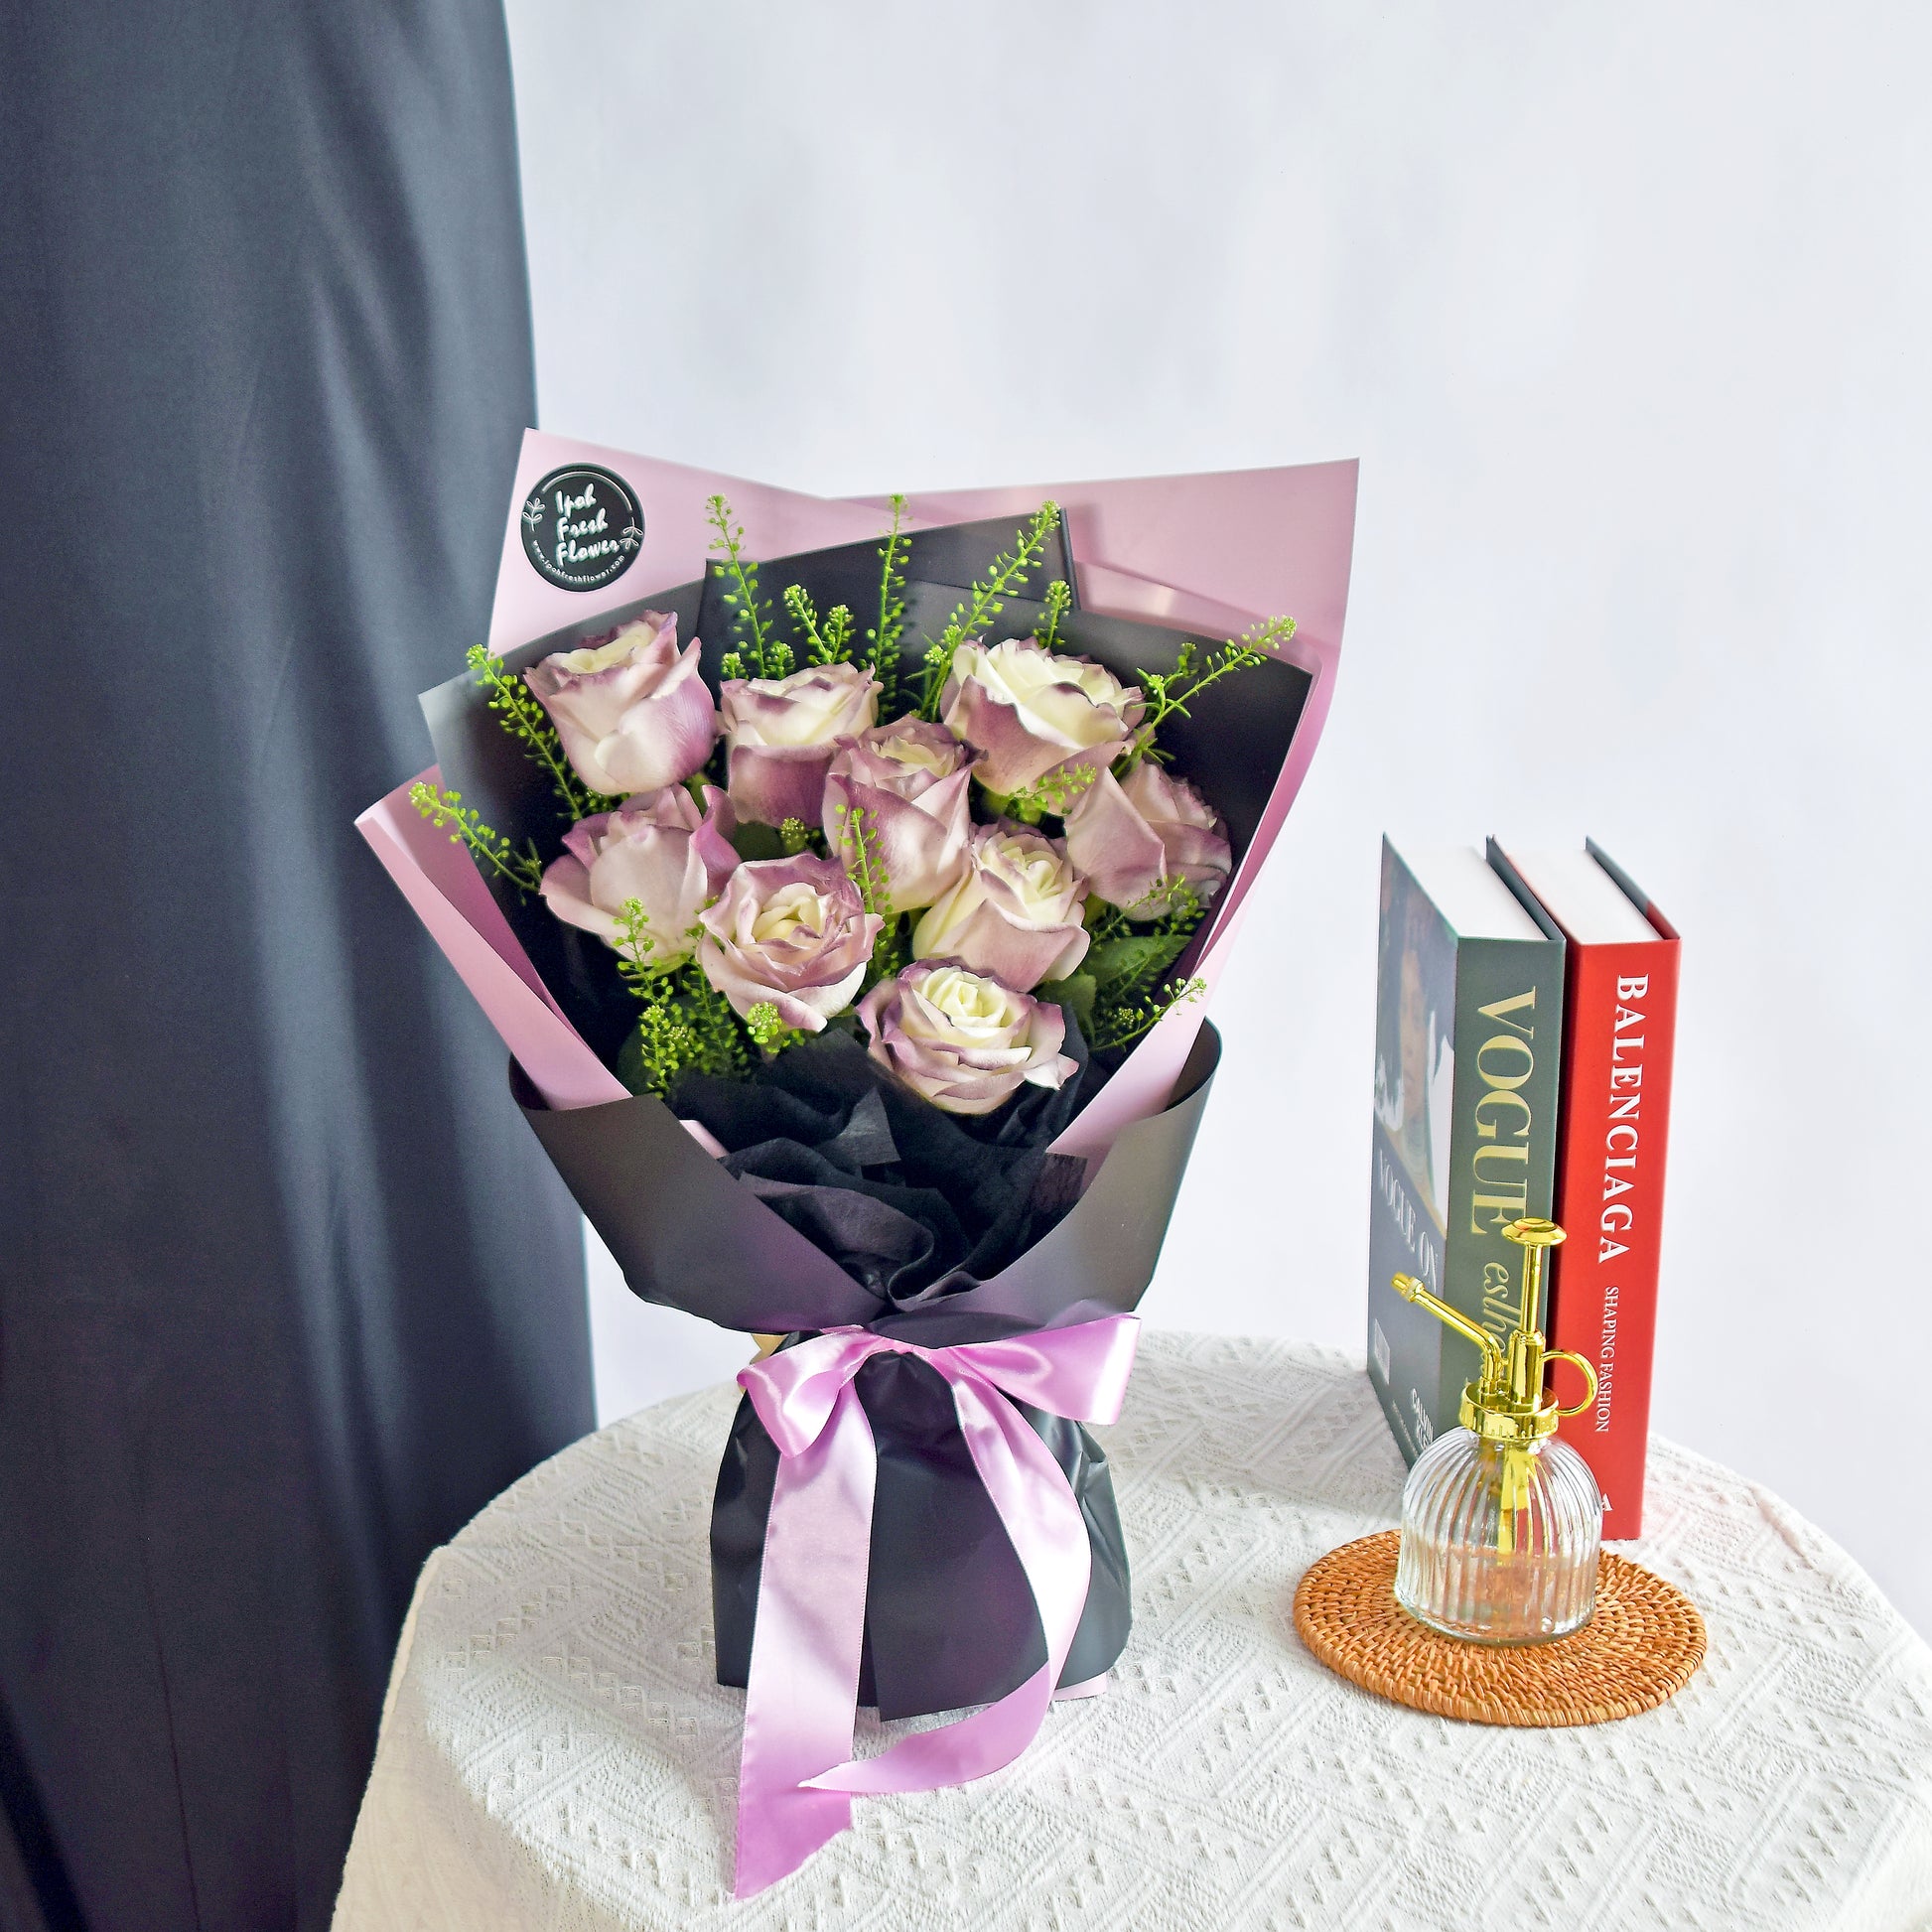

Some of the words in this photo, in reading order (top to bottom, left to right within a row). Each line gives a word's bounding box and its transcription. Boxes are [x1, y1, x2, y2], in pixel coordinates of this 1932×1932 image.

[555, 483, 597, 519] Ipoh
[556, 507, 609, 542] Fresh
[555, 539, 620, 567] Flower
[1471, 986, 1536, 1234] VOGUE
[1598, 973, 1649, 1264] BALENCIAGA
[1600, 1286, 1619, 1359] SHAPING
[1595, 1361, 1614, 1433] FASHION
